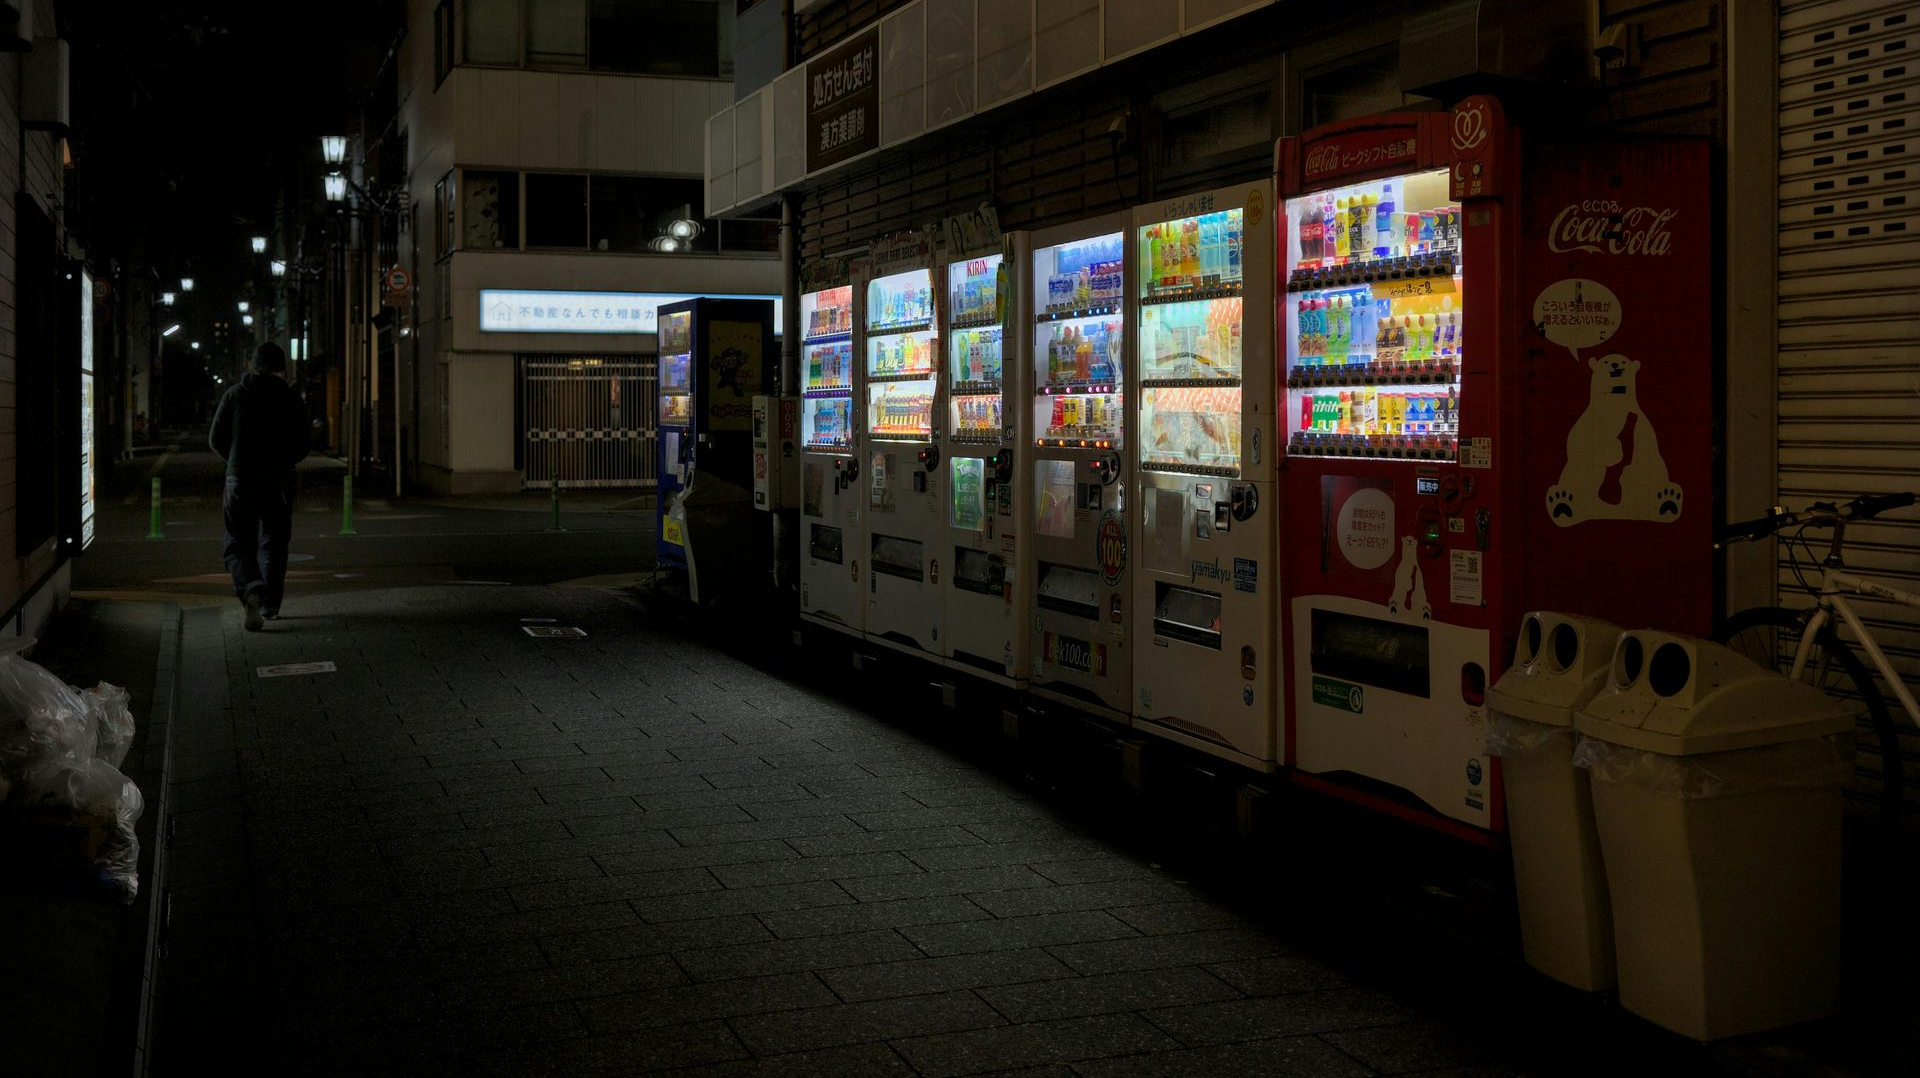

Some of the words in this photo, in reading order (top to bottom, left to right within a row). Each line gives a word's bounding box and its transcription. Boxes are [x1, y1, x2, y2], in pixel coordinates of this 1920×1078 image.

[813, 46, 873, 109] 処方せん受付
[1548, 203, 1680, 257] Coca-Cola
[966, 258, 989, 278] KIRIN
[1102, 537, 1121, 568] 100
[1191, 557, 1232, 584] yamakyu
